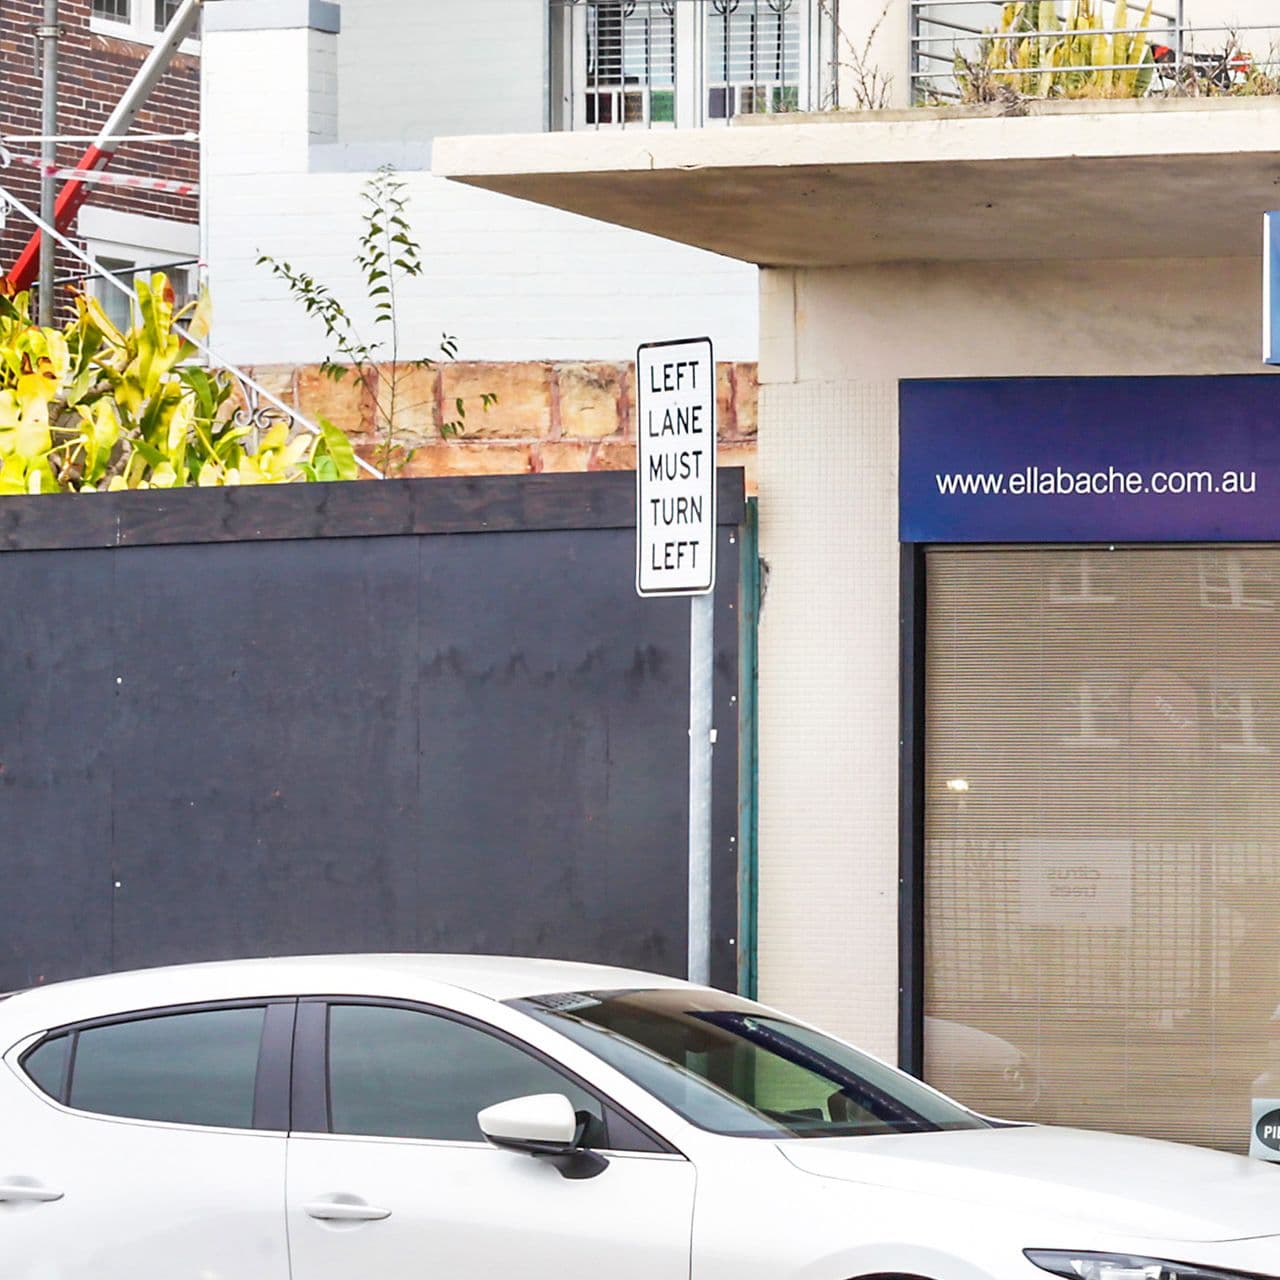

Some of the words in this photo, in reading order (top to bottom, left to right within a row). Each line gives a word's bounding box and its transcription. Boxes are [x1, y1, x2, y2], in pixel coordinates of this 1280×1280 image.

[651, 361, 699, 393] LEFT
[649, 405, 703, 437] LANE
[649, 450, 703, 482] MUST
[935, 466, 1257, 494] www.ellabache.com.au
[650, 495, 703, 526] TURN
[651, 541, 700, 571] LEFT
